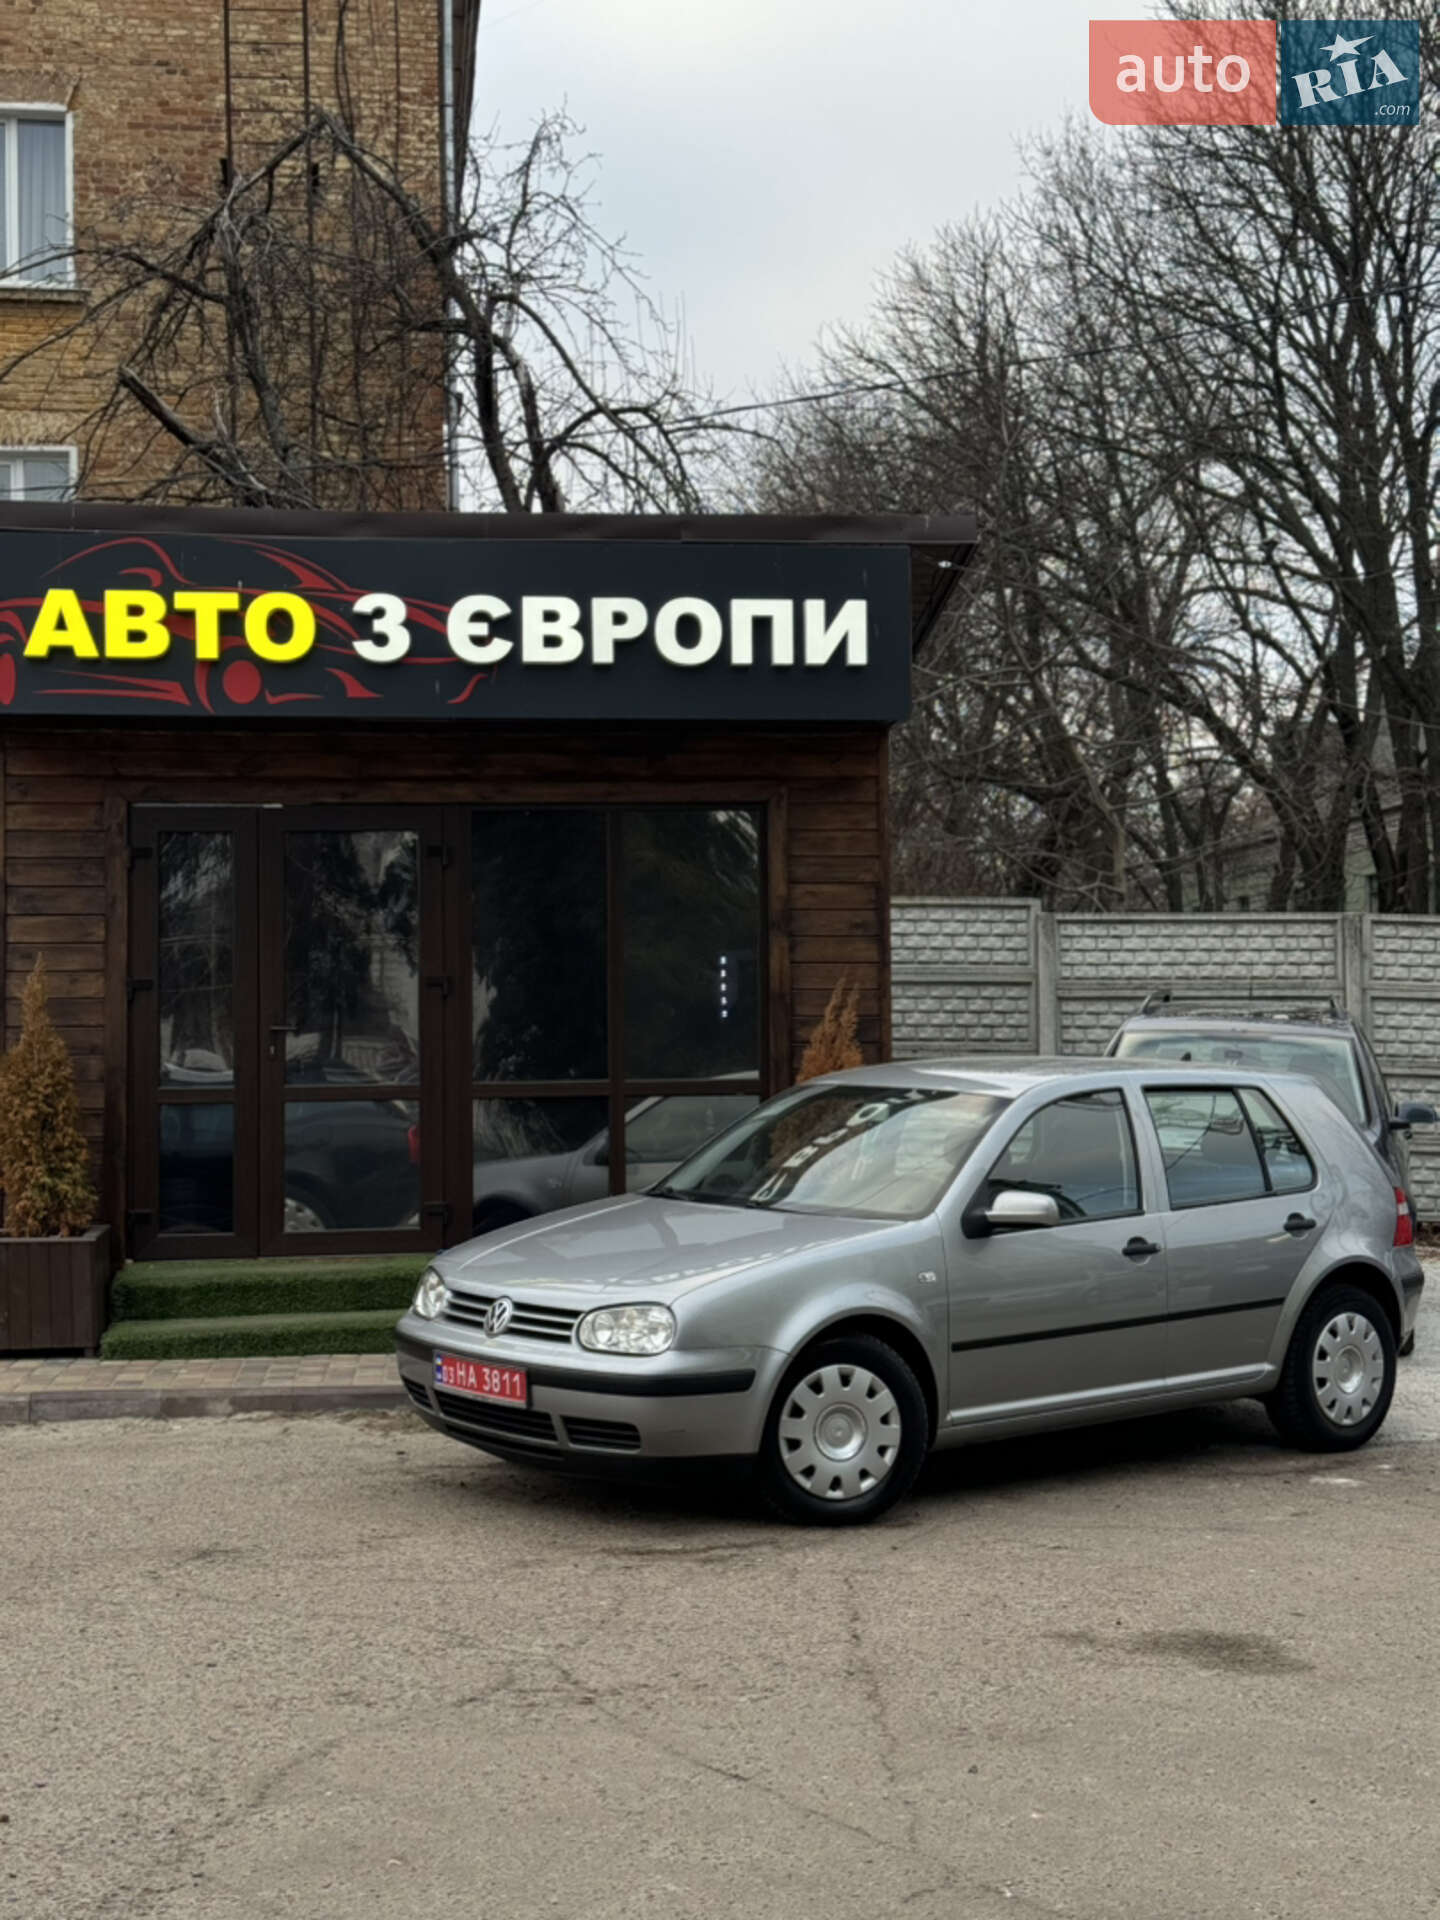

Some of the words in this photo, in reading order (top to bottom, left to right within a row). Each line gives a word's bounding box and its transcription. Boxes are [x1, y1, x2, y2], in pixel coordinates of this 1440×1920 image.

[24, 588, 315, 661] АВТО
[352, 593, 411, 662] З
[446, 594, 868, 666] ЄВРОПИ
[482, 1367, 521, 1397] 3811
